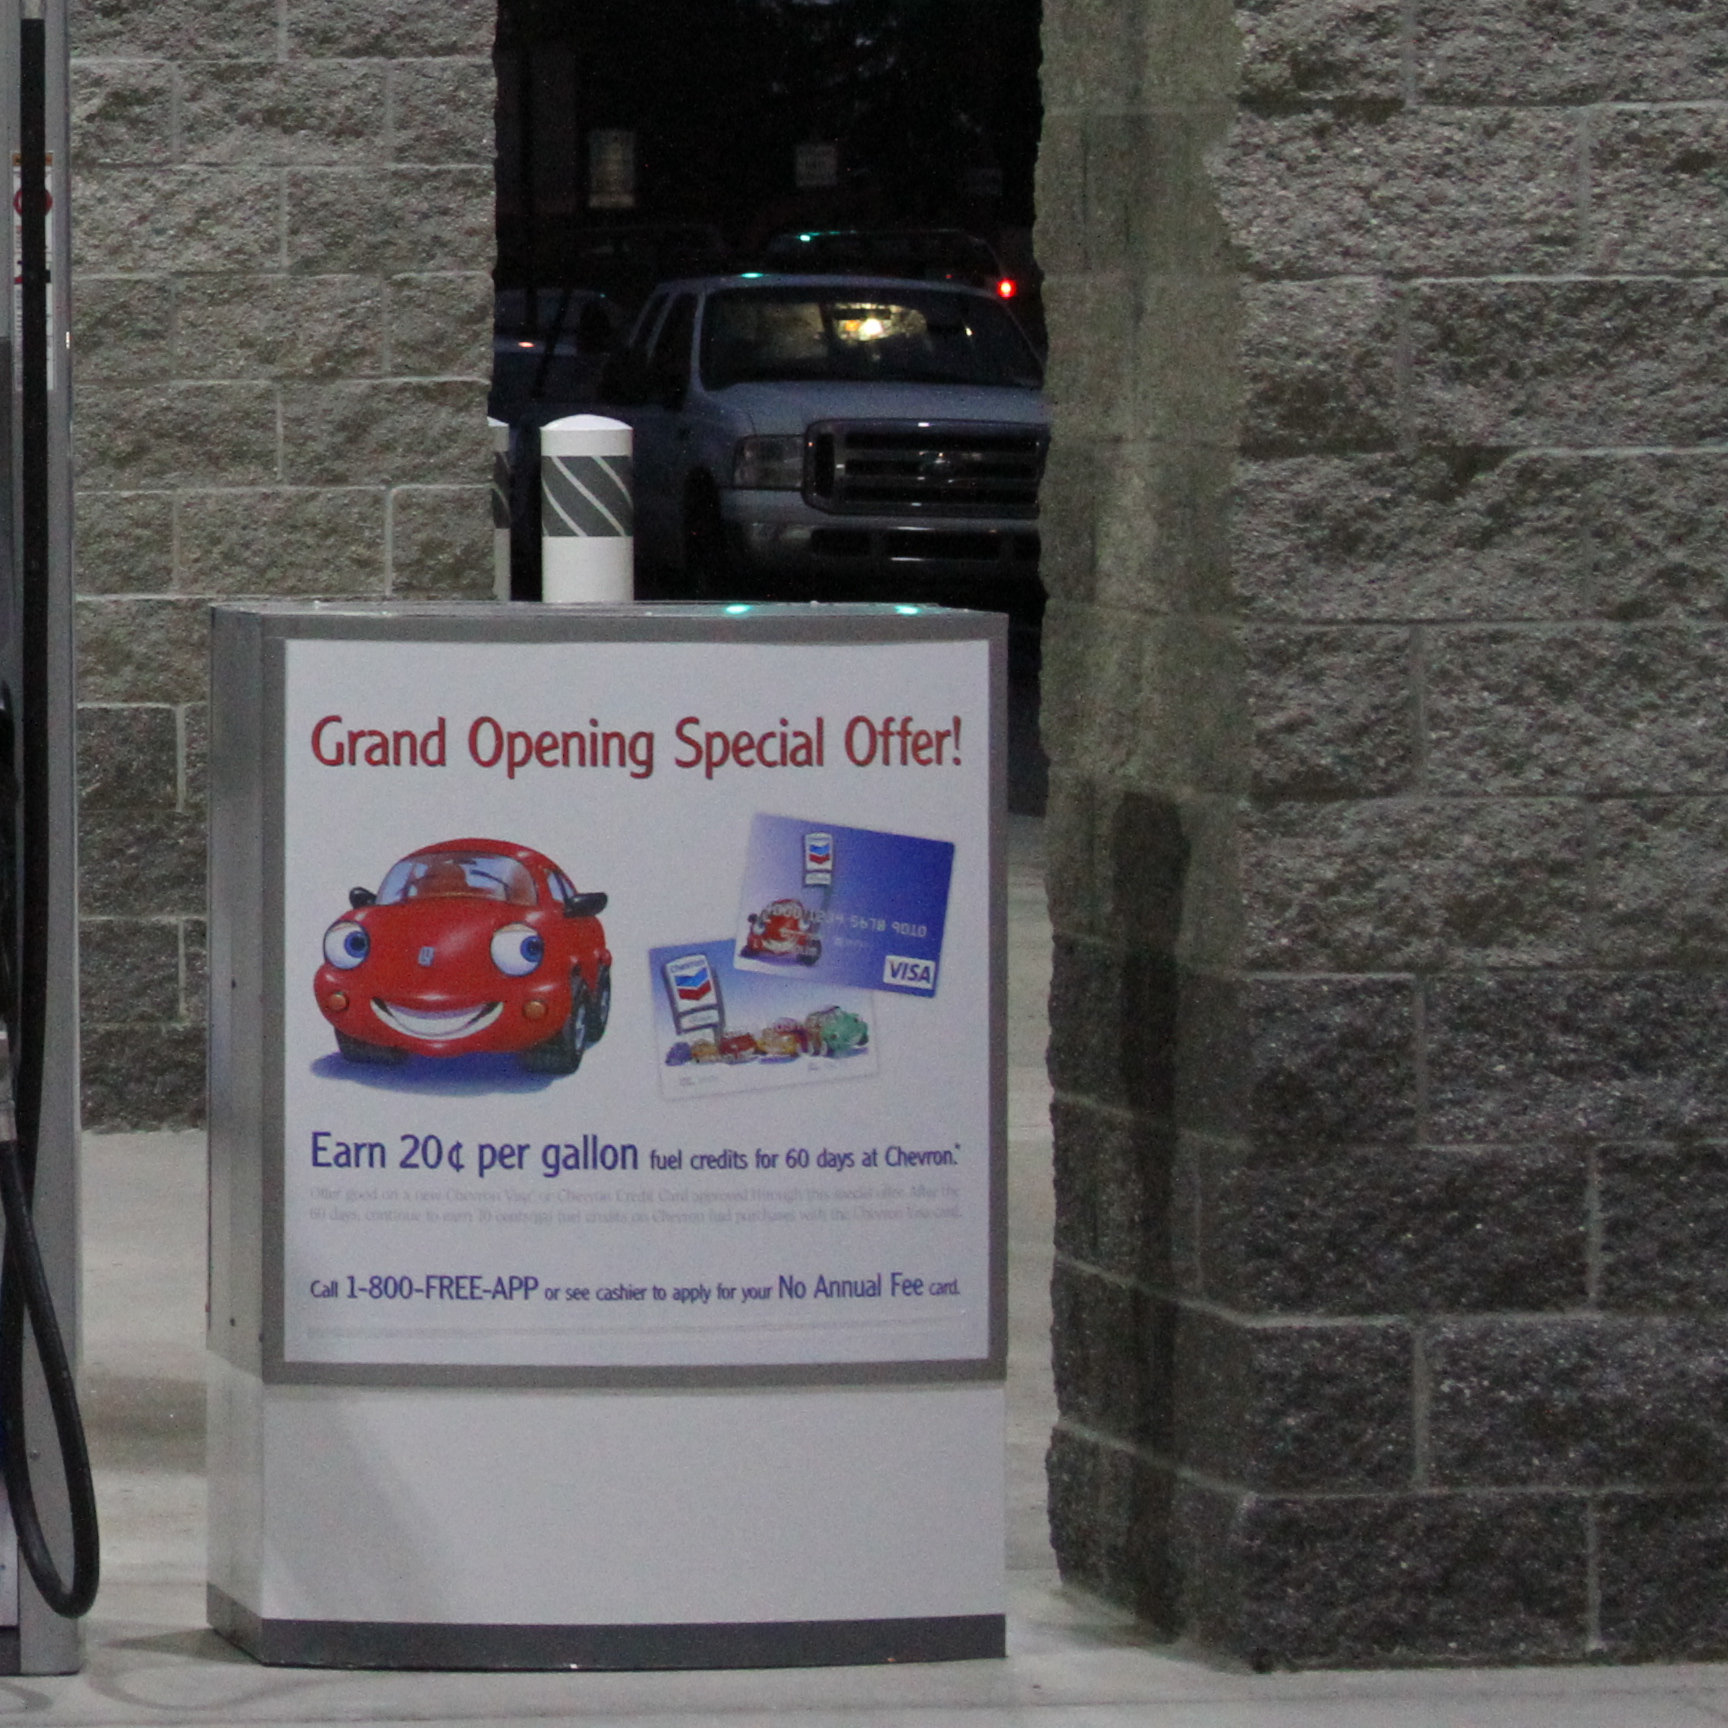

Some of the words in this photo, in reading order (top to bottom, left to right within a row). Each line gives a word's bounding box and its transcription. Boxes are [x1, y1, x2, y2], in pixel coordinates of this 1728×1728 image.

[311, 715, 446, 768] Grand
[468, 715, 655, 779] Opening
[675, 715, 824, 780] Special
[844, 715, 962, 767] Offer!
[889, 962, 932, 984] VISA
[311, 1131, 386, 1168] Earn
[399, 1134, 465, 1172] 20¢
[478, 1143, 530, 1178] per
[542, 1134, 638, 1178] gallon
[650, 1149, 682, 1171] fuel
[690, 1149, 748, 1171] credits
[755, 1148, 779, 1170] for
[785, 1148, 809, 1168] 60
[816, 1148, 855, 1172] days
[861, 1148, 878, 1168] at
[310, 1280, 338, 1298] Call
[347, 1275, 538, 1300] 1-800-FREE-APP
[545, 1288, 560, 1301] or
[565, 1288, 590, 1301] see
[596, 1283, 646, 1301] cashier
[653, 1285, 666, 1300] to
[673, 1283, 711, 1304] apply
[717, 1283, 737, 1299] for
[741, 1286, 772, 1303] your
[779, 1275, 806, 1299] No
[814, 1273, 881, 1299] Annual
[891, 1272, 923, 1296] Fee
[929, 1277, 960, 1296] card.
